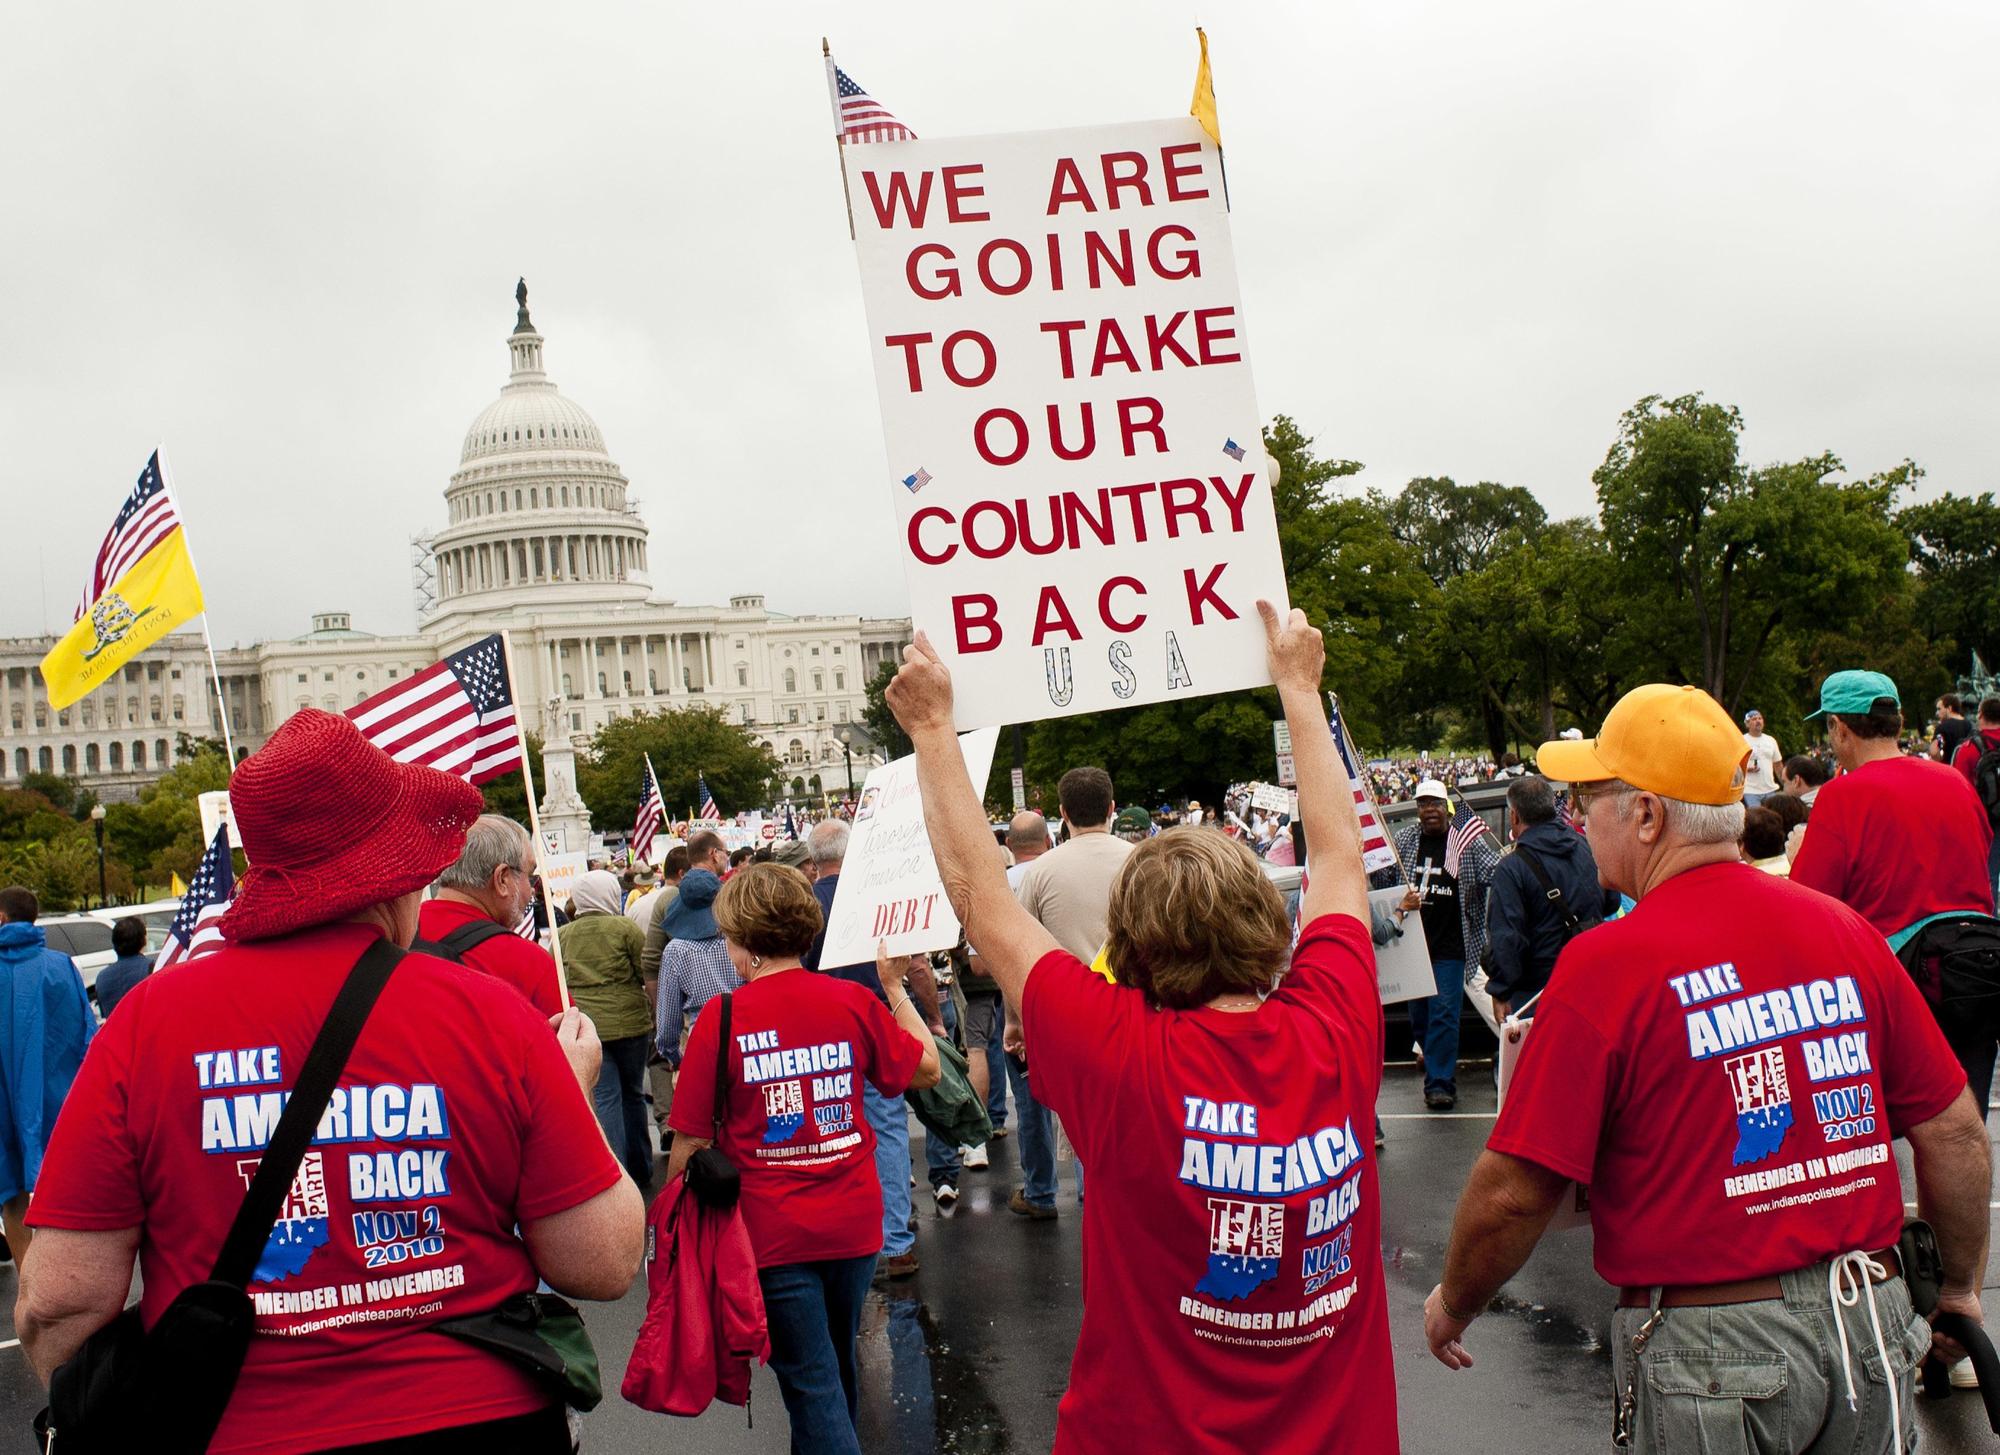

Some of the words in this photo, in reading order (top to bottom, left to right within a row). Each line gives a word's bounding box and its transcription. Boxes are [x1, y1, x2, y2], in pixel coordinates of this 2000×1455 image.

[862, 164, 990, 229] WE
[1046, 142, 1210, 215] ARE
[905, 225, 1201, 300] GOING
[885, 330, 997, 393] TO
[1040, 306, 1242, 379] TAKE
[974, 396, 1170, 466] OUR
[907, 473, 1256, 565] COUNTRY
[951, 562, 1240, 655] BACK
[872, 893, 938, 938] DEBT
[1431, 885, 1452, 896] Faith
[1668, 962, 1743, 1007] TAKE
[736, 1030, 779, 1053] TAKE
[1686, 976, 1866, 1060] AMERICA
[194, 1046, 281, 1088] TAKE
[743, 1041, 854, 1083] AMERICA
[1773, 1050, 1789, 1101] PARTY
[1801, 1031, 1872, 1083] BACK
[812, 1072, 853, 1102] BACK
[1812, 1087, 1860, 1124] NOV
[1862, 1084, 1875, 1114] 2
[202, 1083, 449, 1153] AMRICA
[813, 1104, 842, 1125] NOV
[844, 1102, 853, 1121] 2
[1184, 1095, 1258, 1137] TAKE
[1824, 1117, 1876, 1143] 2010
[348, 1149, 450, 1202] BACK
[756, 1145, 807, 1157] REMEMBER
[808, 1144, 818, 1154] IN
[1178, 1115, 1364, 1197] AMERICA
[1724, 1162, 1806, 1197] REMEMBER
[1806, 1158, 1827, 1179] IN
[1827, 1143, 1888, 1176] NOVEMBER
[307, 1154, 327, 1217] PARTY
[1306, 1170, 1362, 1239] BACK
[353, 1210, 418, 1248] NOV
[423, 1206, 444, 1236] 2
[364, 1236, 444, 1268] 2010
[1208, 1198, 1266, 1257] TEA
[1265, 1205, 1283, 1257] PARTY
[1302, 1236, 1343, 1279] NOV
[1341, 1223, 1352, 1252] 2
[248, 1287, 337, 1315] MEMBER
[341, 1283, 362, 1306] IN
[365, 1265, 465, 1300] NOVEMBER
[1303, 1254, 1351, 1296] 2010
[256, 1301, 443, 1337] www.indianapolisteaparty.com
[1180, 1296, 1273, 1330] REMEMBER
[1276, 1311, 1295, 1330] IN
